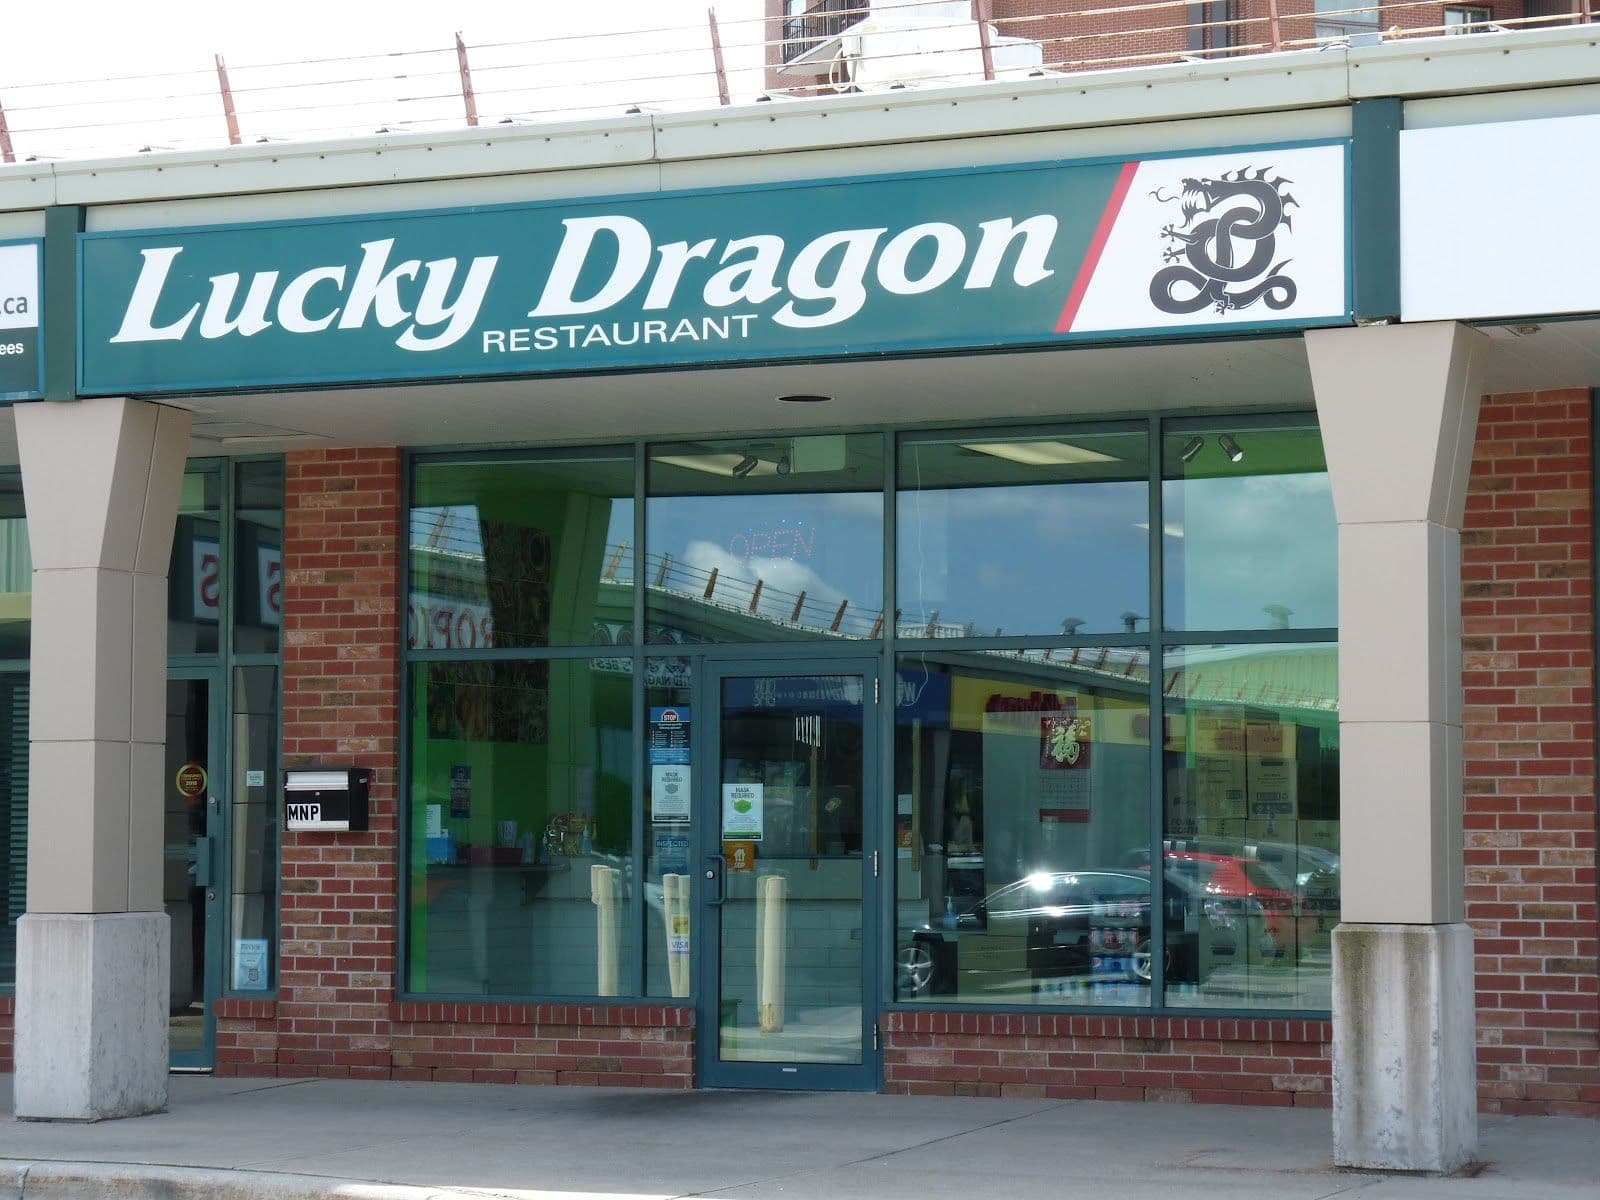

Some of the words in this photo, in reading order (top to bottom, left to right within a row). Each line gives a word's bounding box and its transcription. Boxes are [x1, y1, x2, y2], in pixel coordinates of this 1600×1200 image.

[110, 237, 499, 352] Lucky
[527, 214, 1059, 329] Dragon
[483, 314, 758, 353] RESTAURANT
[728, 528, 817, 564] OPEN
[288, 805, 319, 821] MNP
[672, 941, 689, 949] VISA
